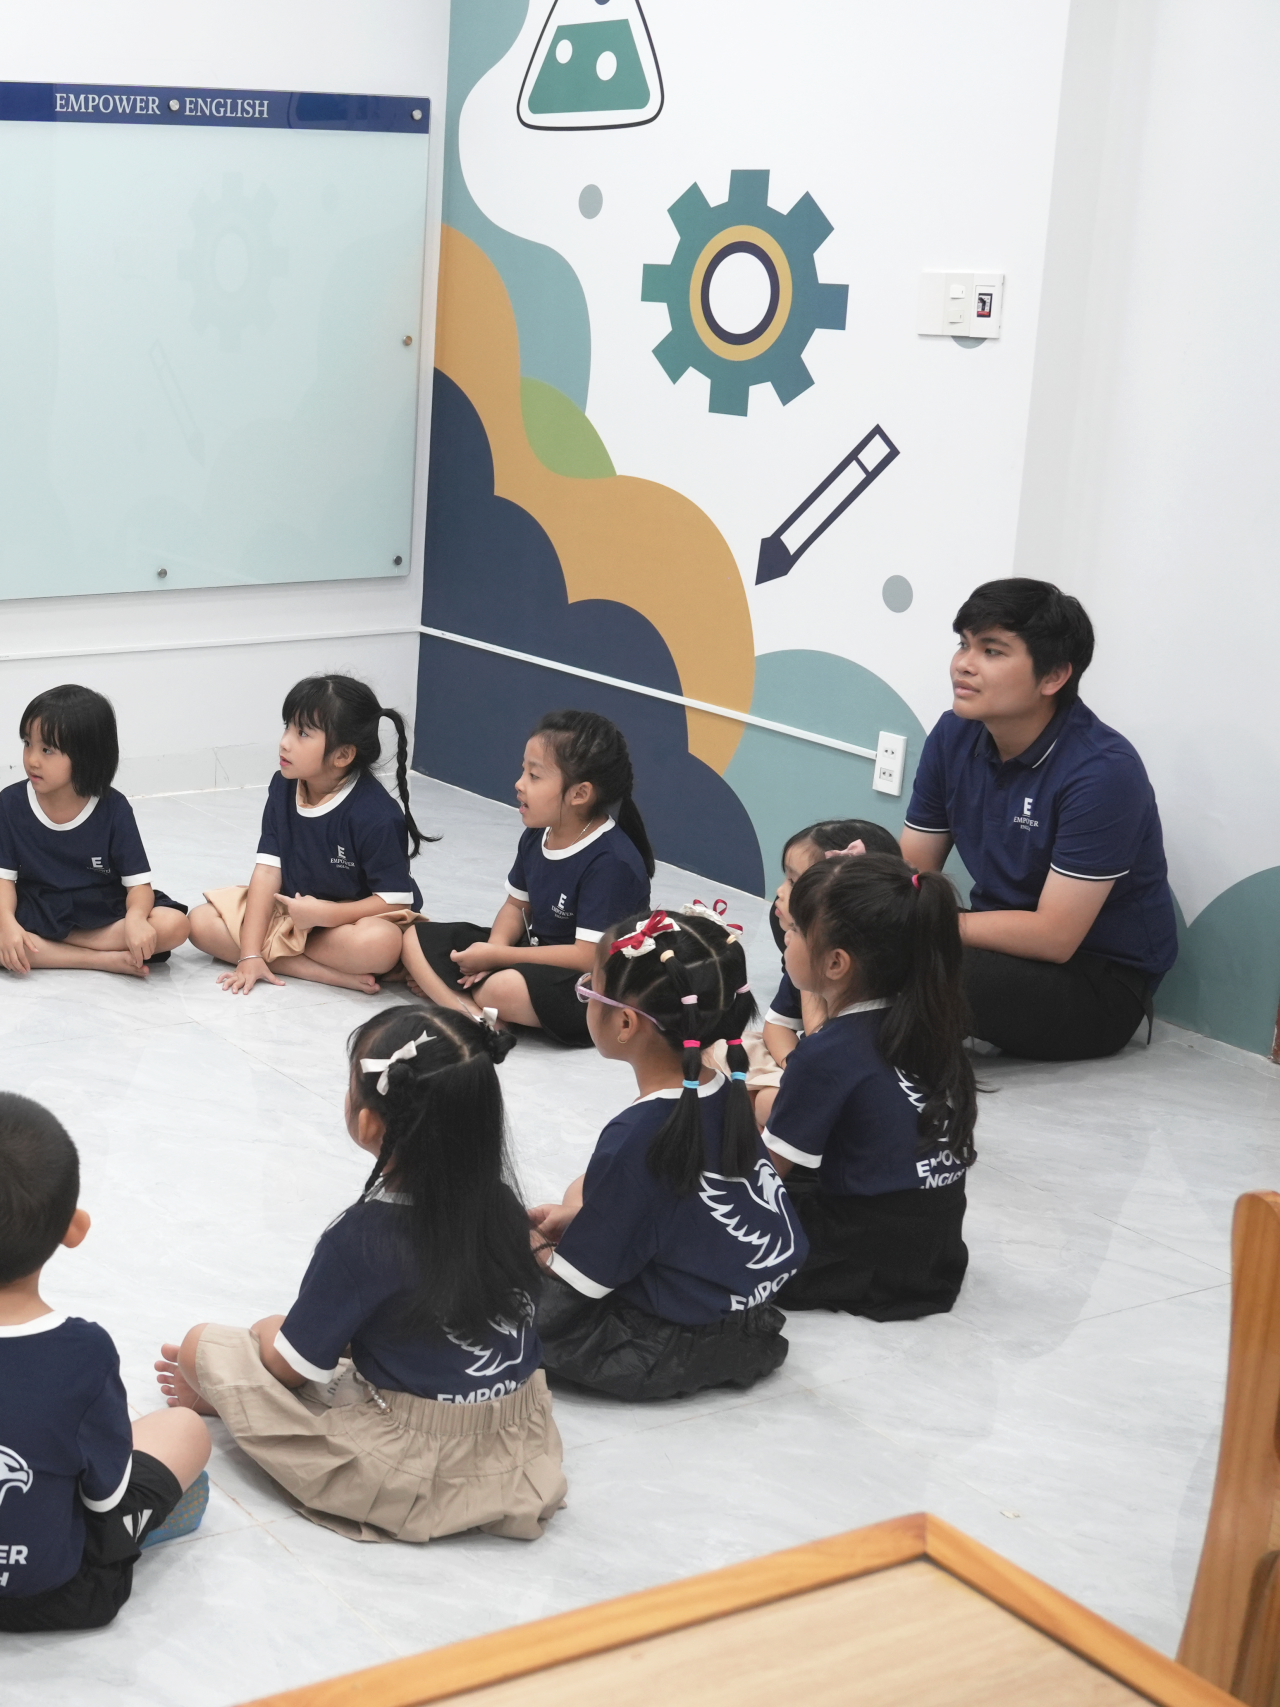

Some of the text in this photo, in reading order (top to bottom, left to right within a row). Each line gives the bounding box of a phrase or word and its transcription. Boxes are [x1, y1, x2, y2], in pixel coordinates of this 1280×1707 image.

[55, 93, 269, 118] EMPOWER ENGLISH
[1024, 797, 1033, 815] E
[337, 845, 346, 858] E
[91, 856, 104, 868] E
[558, 893, 567, 909] E
[730, 1268, 797, 1311] EMPO
